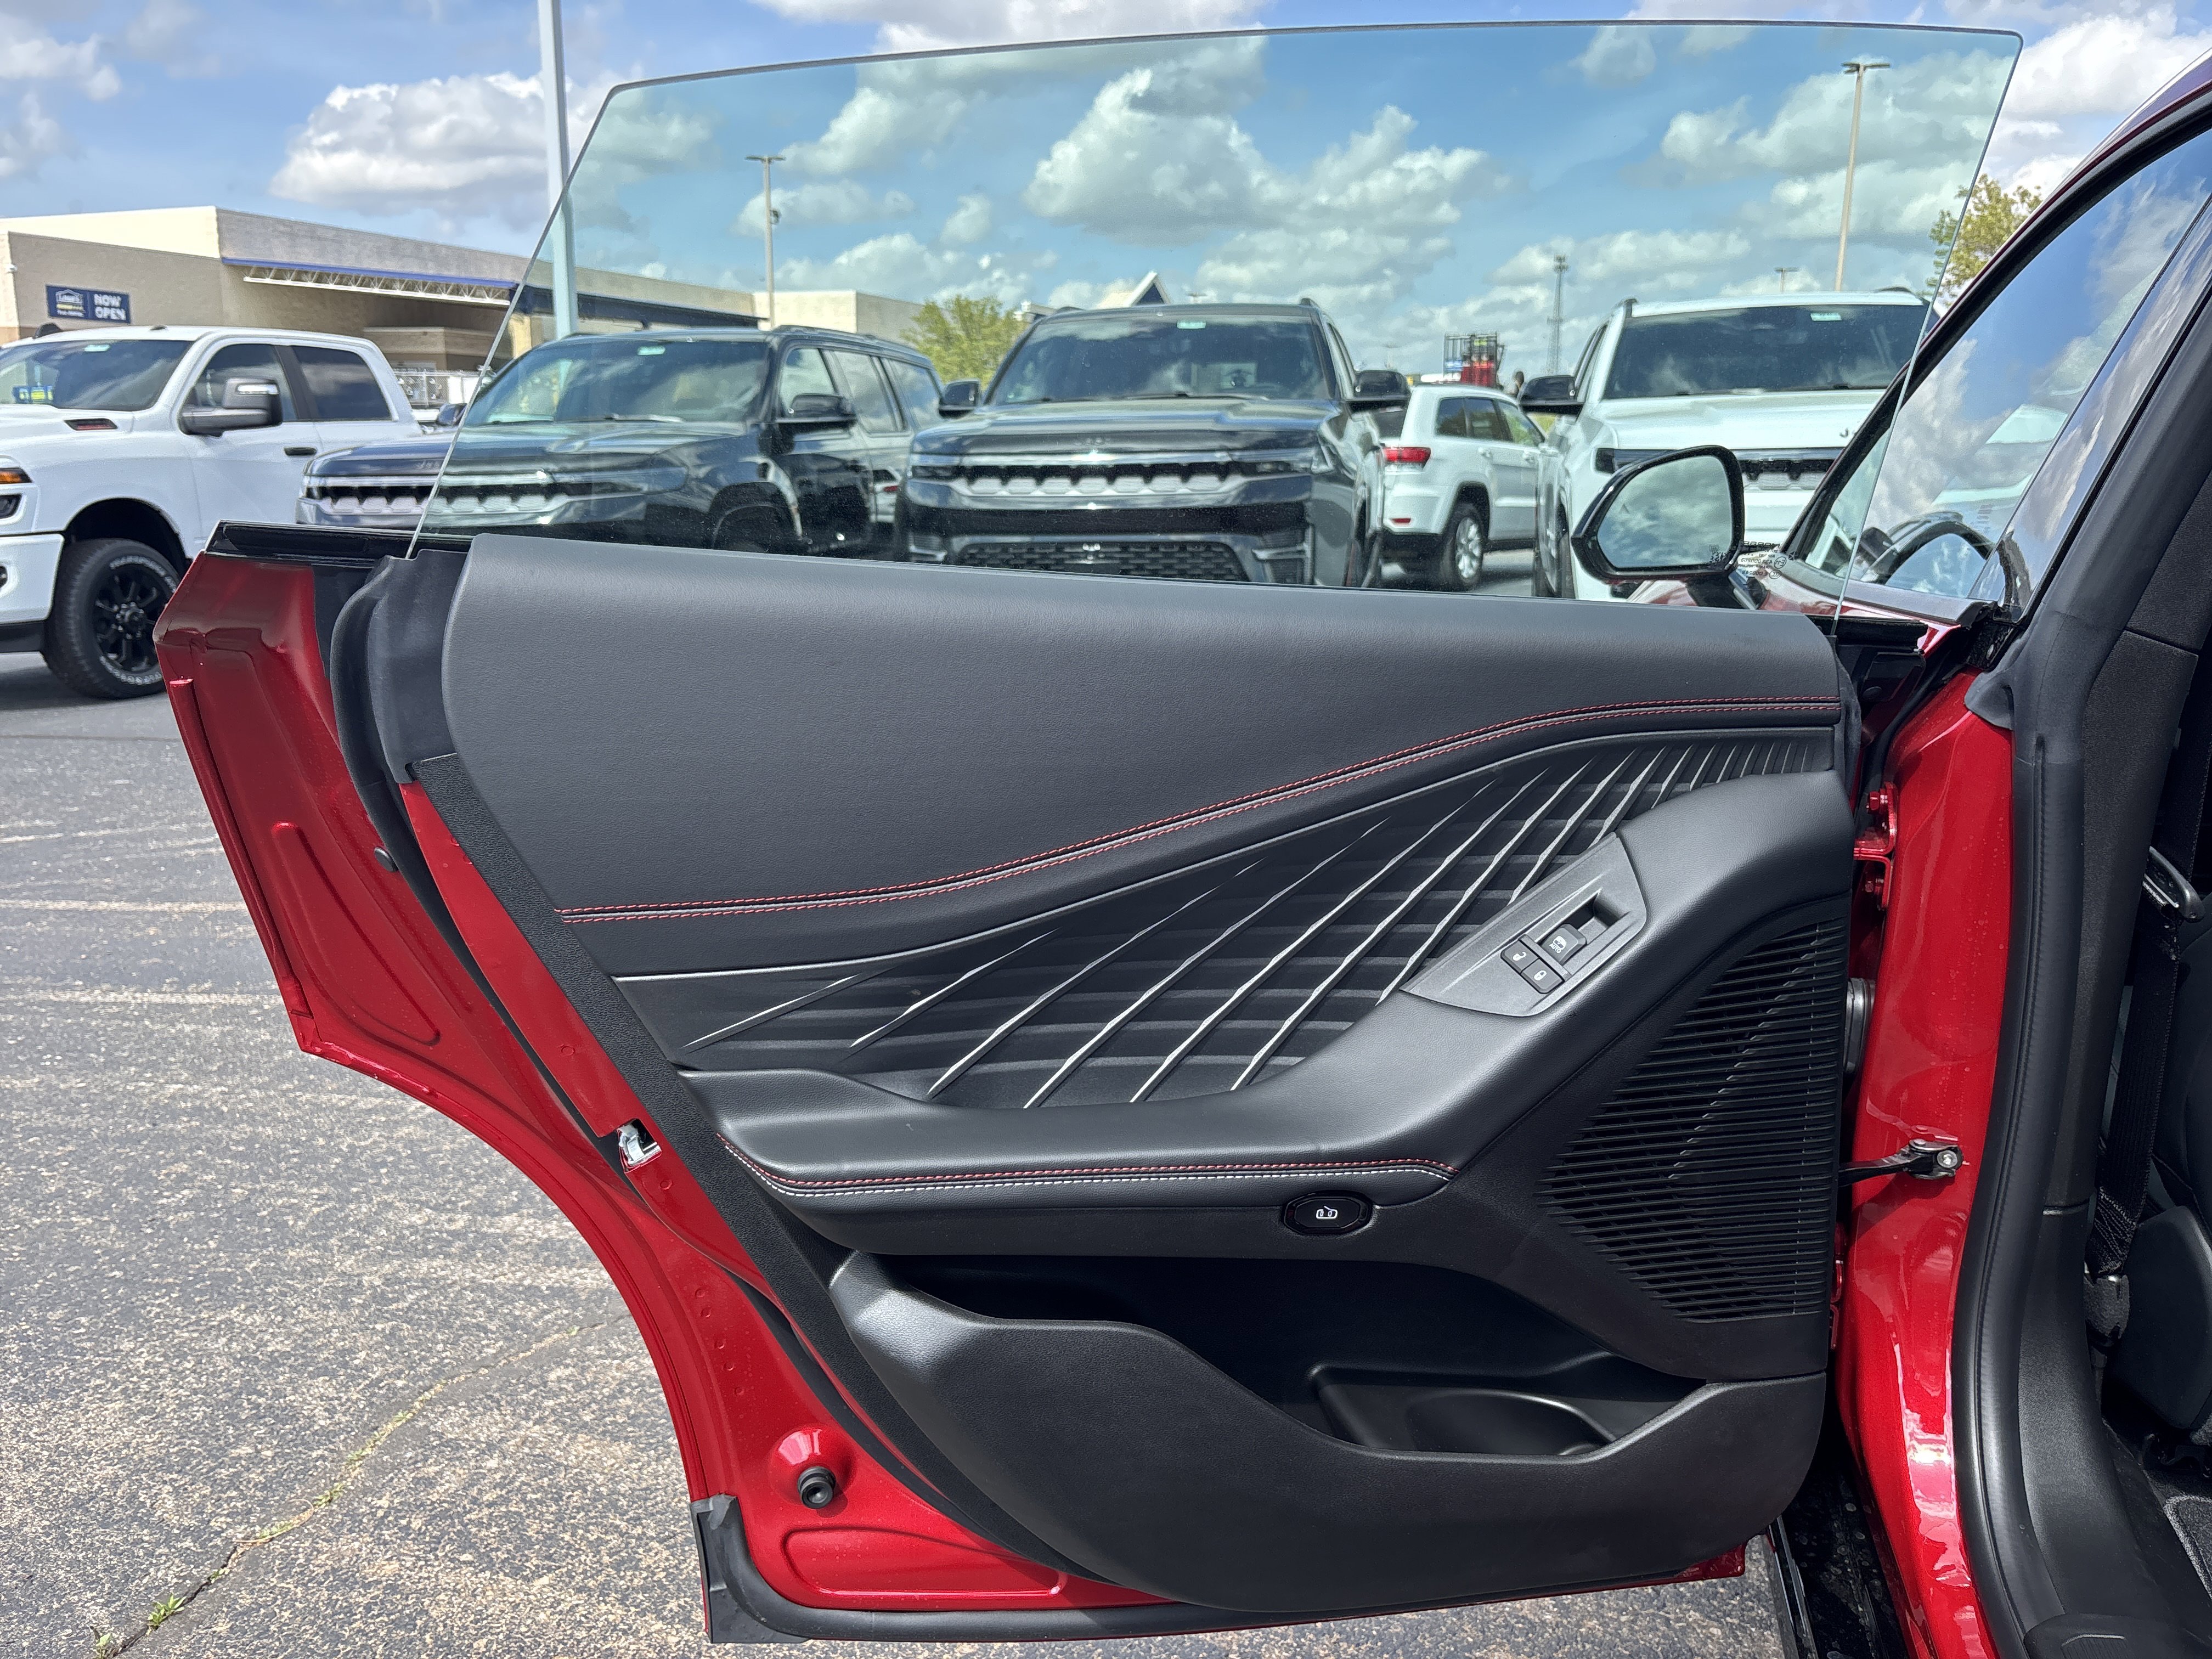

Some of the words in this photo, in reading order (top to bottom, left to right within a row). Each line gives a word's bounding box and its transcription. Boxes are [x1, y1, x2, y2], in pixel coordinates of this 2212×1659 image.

[93, 294, 122, 307] NOW
[94, 306, 127, 320] OPEN
[1549, 943, 1561, 953] AUTO
